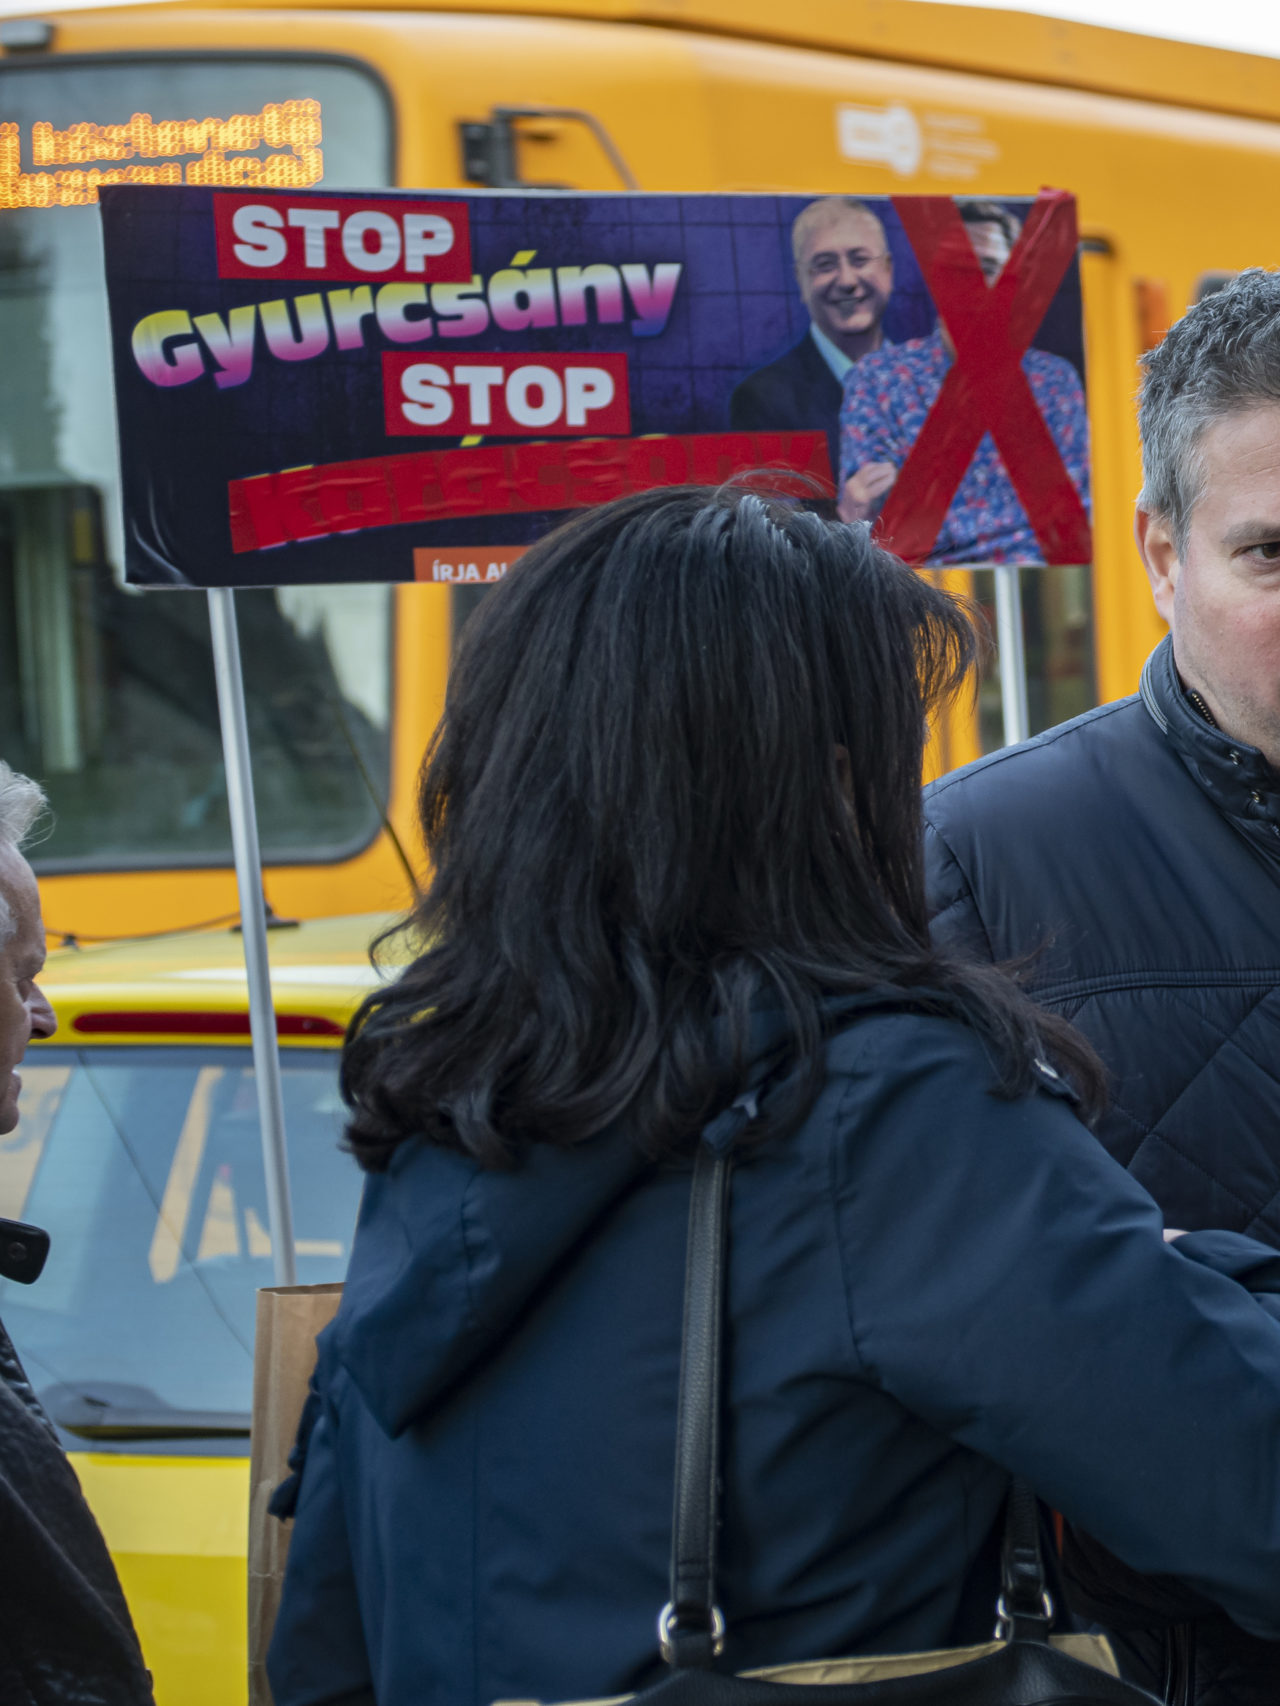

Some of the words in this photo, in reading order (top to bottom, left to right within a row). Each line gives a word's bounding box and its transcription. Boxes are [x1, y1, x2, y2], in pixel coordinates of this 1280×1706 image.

[232, 204, 455, 273] STOP
[131, 249, 683, 390] Gyurcsány
[400, 363, 615, 428] STOP
[432, 558, 481, 582] ÍRJA
